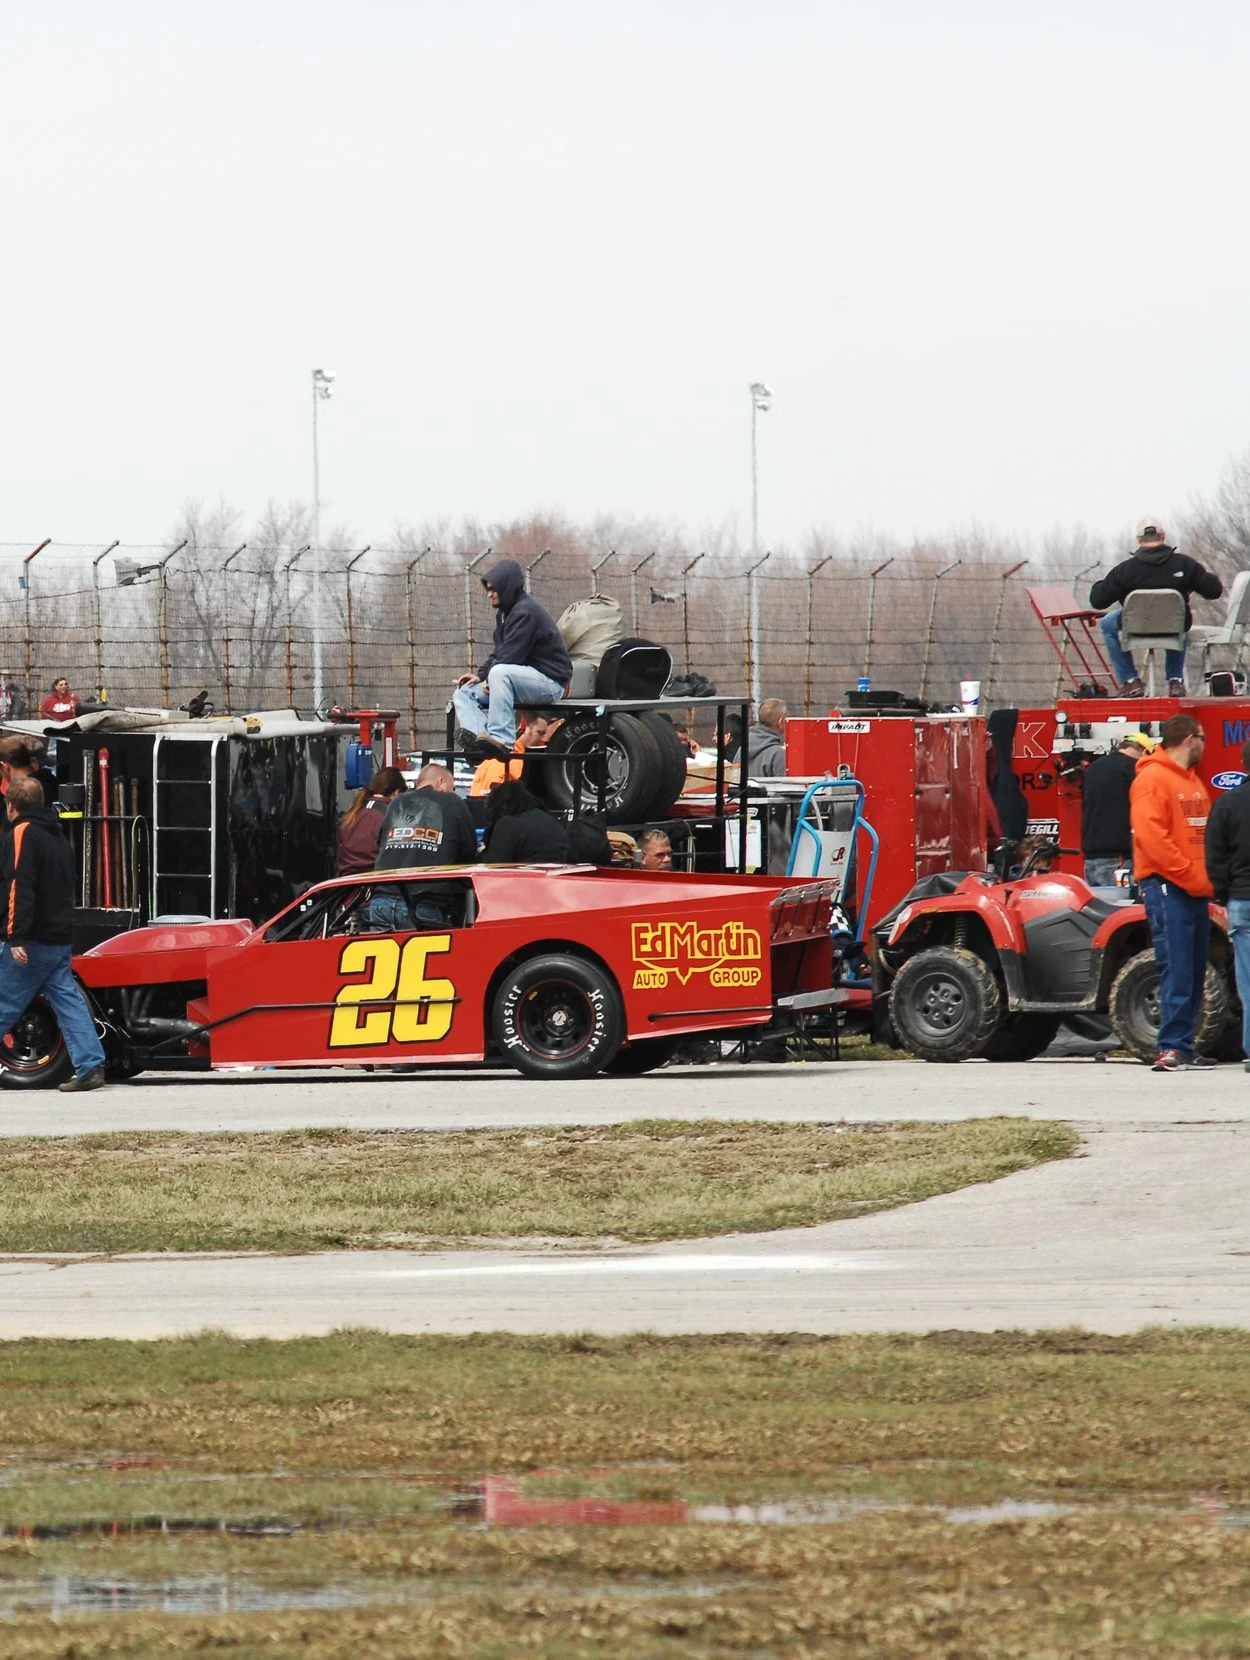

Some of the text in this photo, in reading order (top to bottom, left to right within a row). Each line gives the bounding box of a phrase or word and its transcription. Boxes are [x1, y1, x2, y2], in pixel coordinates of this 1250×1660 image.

[393, 827, 440, 841] EDCO
[328, 933, 456, 1049] 26
[636, 970, 760, 986] AUTO GROUP
[503, 984, 524, 1049] Hoosier
[587, 988, 607, 1053] Hoosier
